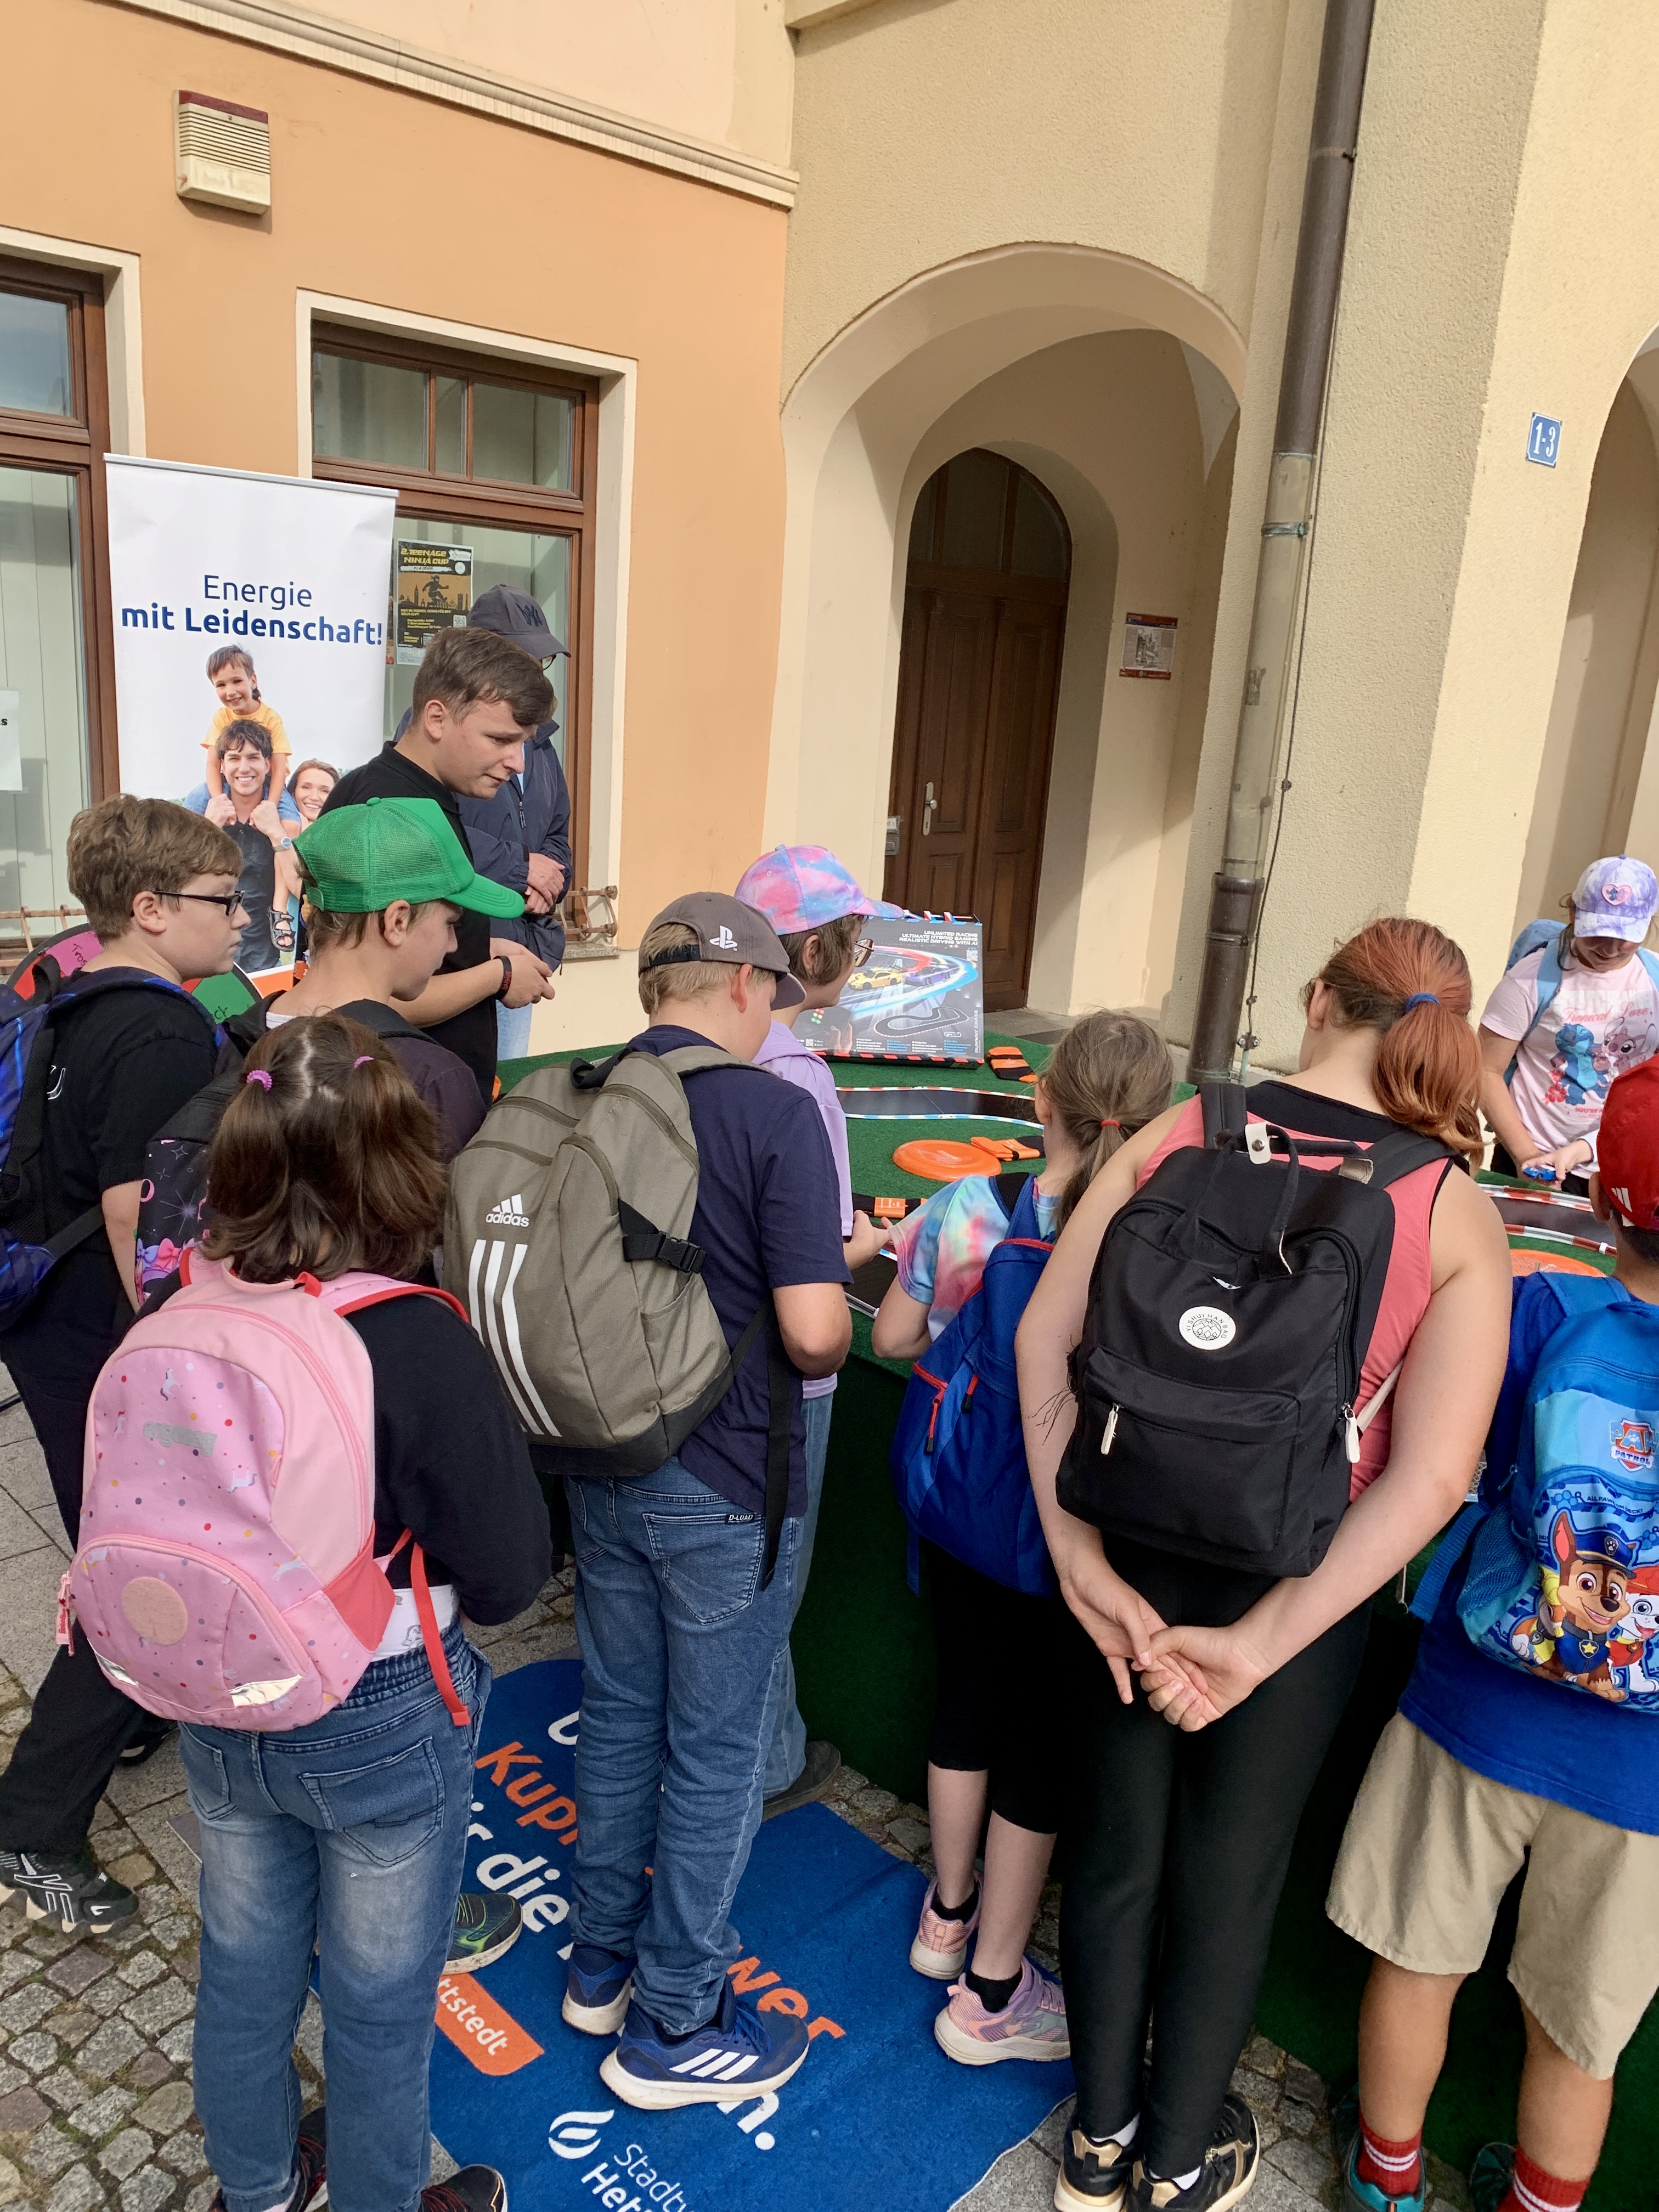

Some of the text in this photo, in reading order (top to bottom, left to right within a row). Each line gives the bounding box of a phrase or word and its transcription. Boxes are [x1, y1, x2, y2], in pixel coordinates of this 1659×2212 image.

[403, 557, 431, 565] NINJA
[204, 574, 312, 611] Energie
[121, 602, 383, 645] mit Leidenschaft!
[1564, 1001, 1649, 1024] Tropical Love
[486, 1212, 529, 1227] adidas
[1186, 1313, 1205, 1332] YISHUI
[1207, 1314, 1224, 1324] HAN
[1615, 1449, 1650, 1464] PATROL
[475, 1741, 579, 1846] Kup
[476, 1854, 570, 1933] die
[581, 2162, 653, 2212] Het
